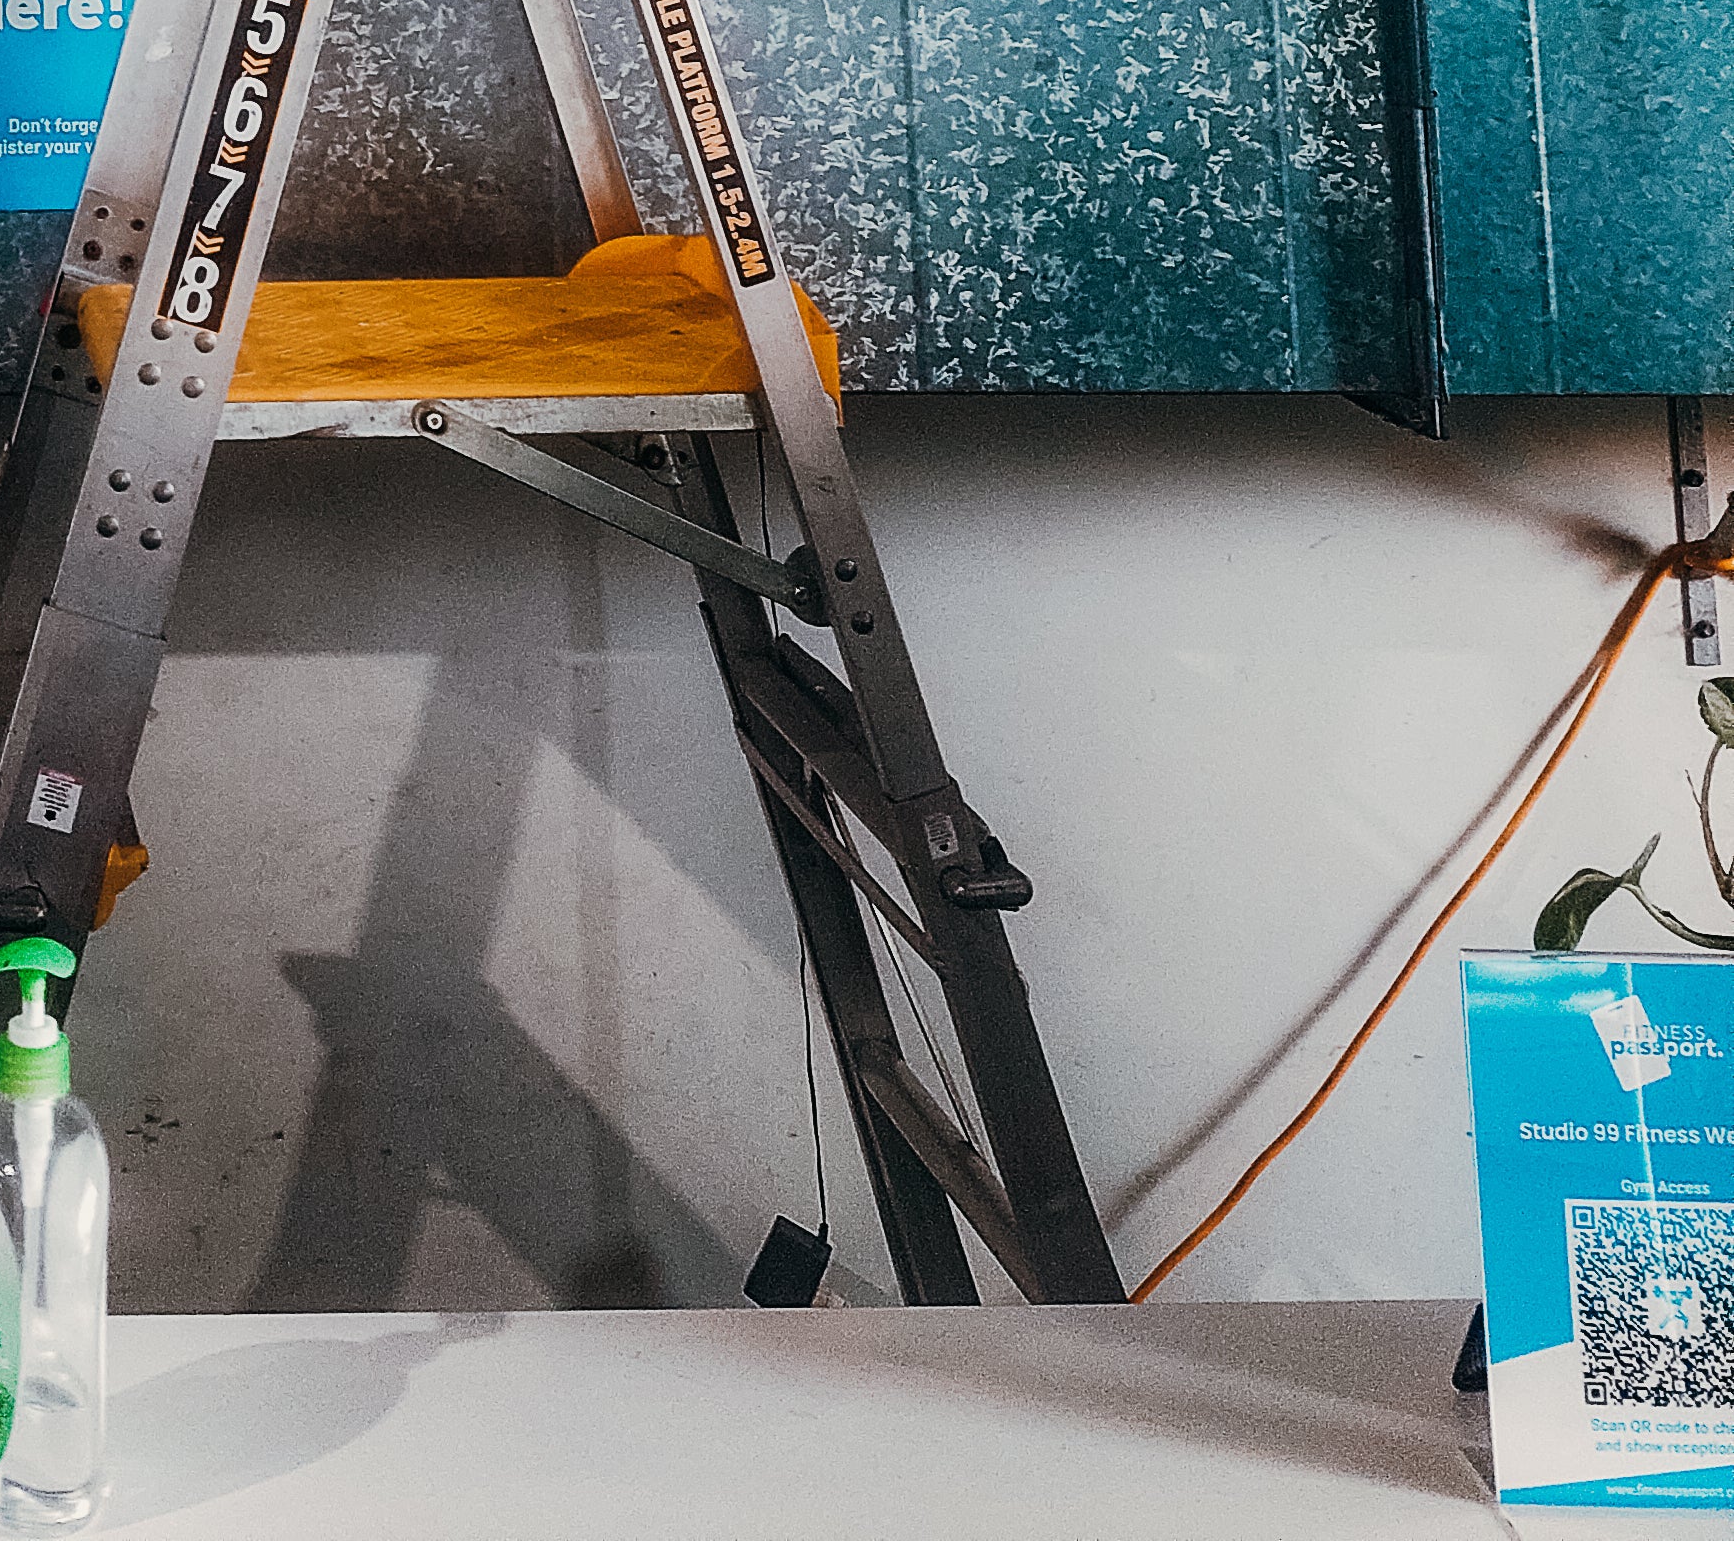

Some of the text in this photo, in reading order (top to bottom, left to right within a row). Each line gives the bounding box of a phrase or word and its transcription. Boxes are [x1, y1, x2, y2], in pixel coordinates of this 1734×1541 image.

[667, 29, 730, 161] PLATFORM
[223, 75, 267, 142] 6
[9, 118, 51, 133] Don’t
[45, 142, 81, 158] your
[201, 163, 245, 230] 7
[173, 256, 219, 322] 8
[1623, 1024, 1706, 1041] FITNESS
[1519, 1121, 1589, 1141] Studio
[1593, 1123, 1620, 1142] 99
[1624, 1124, 1702, 1144] Fitness
[1657, 1180, 1711, 1195] Access
[1591, 1418, 1627, 1433] Scan
[1630, 1420, 1651, 1433] QR
[1656, 1421, 1691, 1434] code
[1694, 1422, 1709, 1434] to
[1595, 1440, 1621, 1452] and
[1626, 1441, 1663, 1453] show
